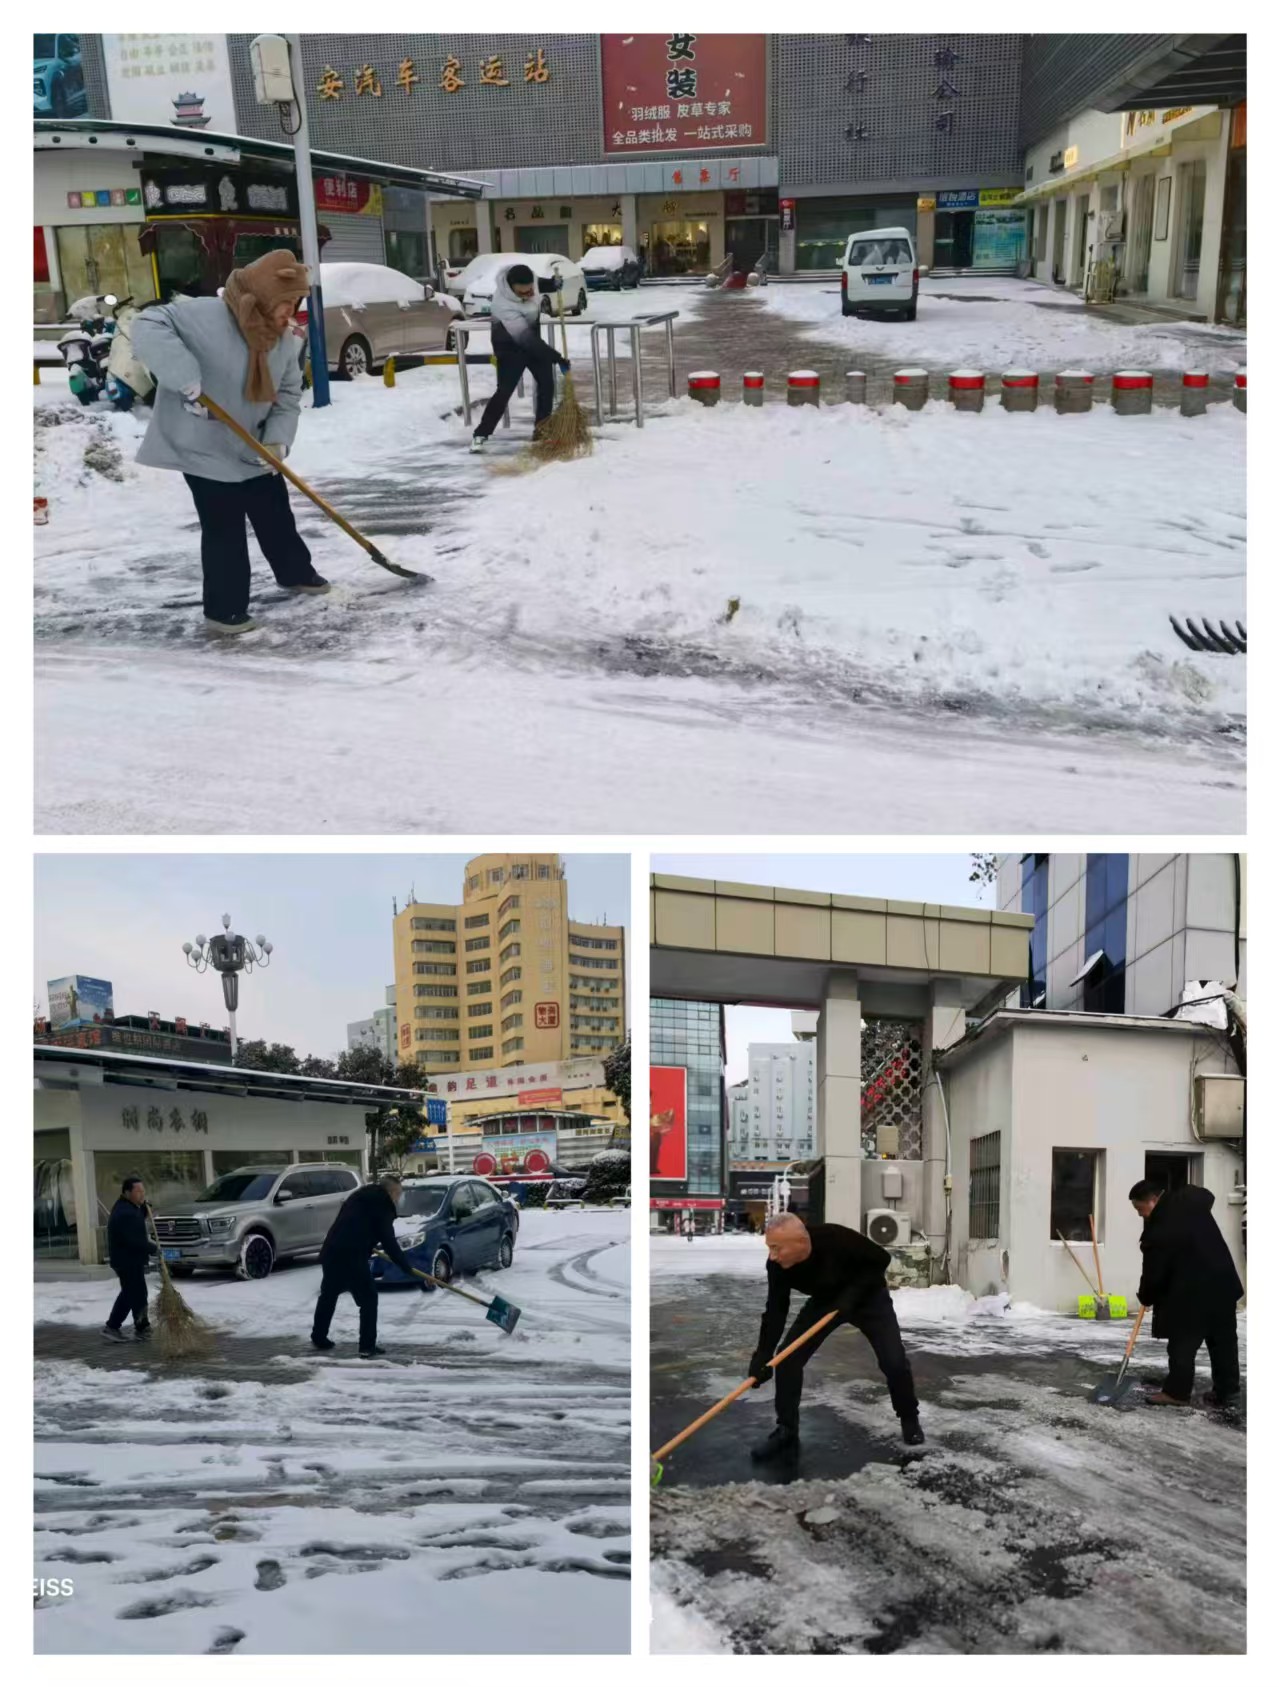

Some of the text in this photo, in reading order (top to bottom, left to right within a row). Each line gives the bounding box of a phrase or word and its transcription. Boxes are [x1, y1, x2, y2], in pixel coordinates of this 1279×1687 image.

[317, 49, 551, 100] 安汽车客运站
[665, 33, 698, 100] 女装
[631, 101, 731, 121] 羽绒服 皮草专家
[612, 124, 752, 145] 全品类批发 一站式采购
[323, 178, 358, 198] 便利店
